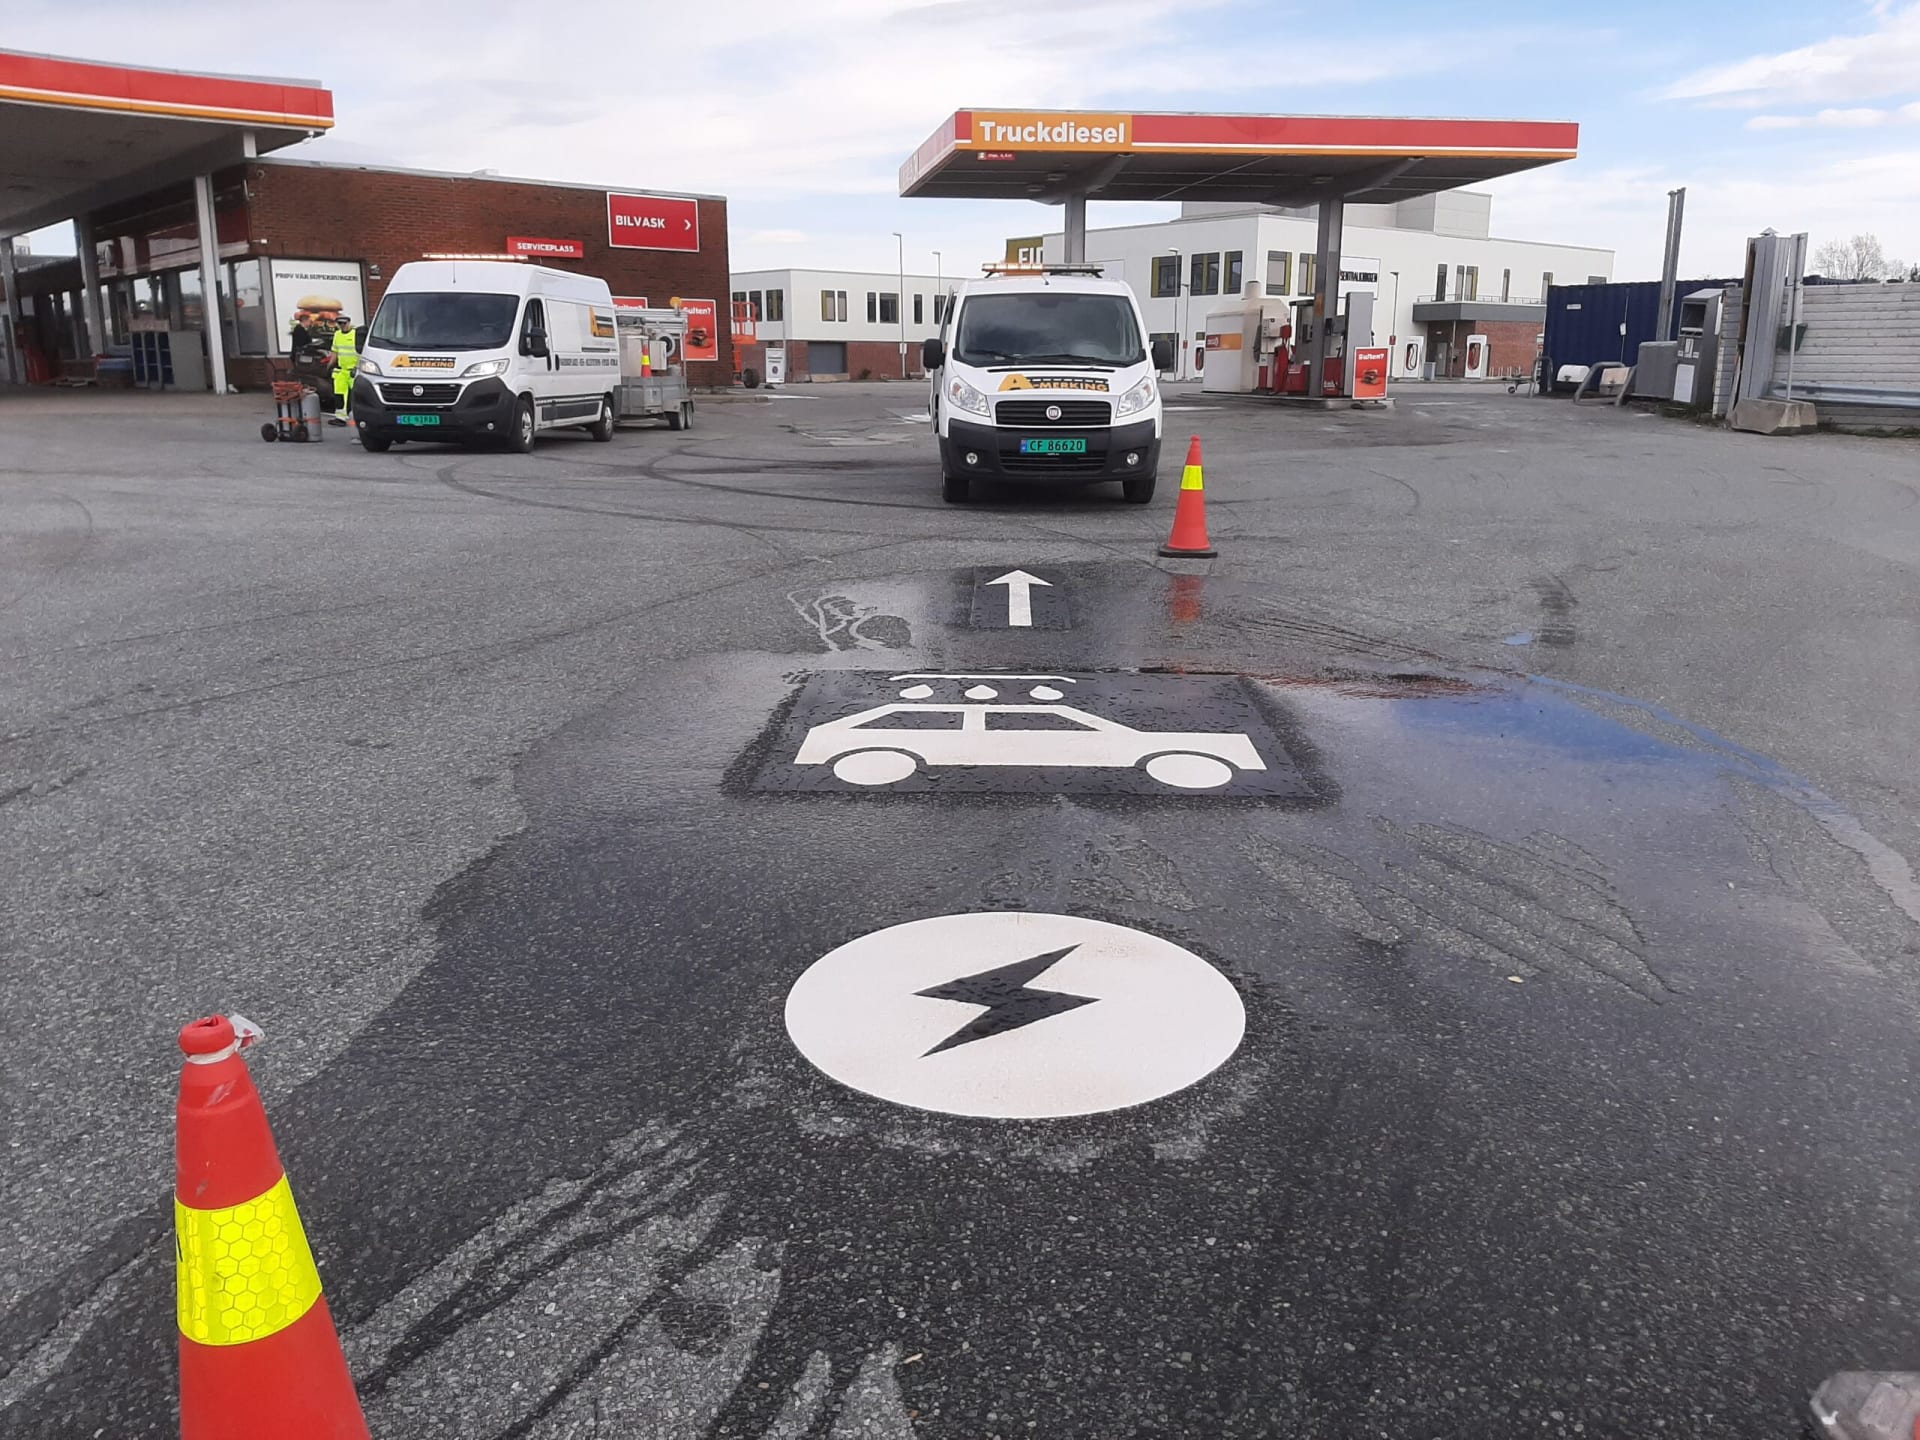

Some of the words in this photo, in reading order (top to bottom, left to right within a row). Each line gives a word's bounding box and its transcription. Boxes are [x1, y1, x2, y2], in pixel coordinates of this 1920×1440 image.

[979, 121, 1124, 143] Truckdiesel
[615, 215, 665, 228] BILVASK
[517, 242, 574, 252] SERVICEPLASS
[998, 374, 1109, 392] A-MERKING
[1029, 441, 1043, 451] CF
[1047, 441, 1083, 451] 86620
